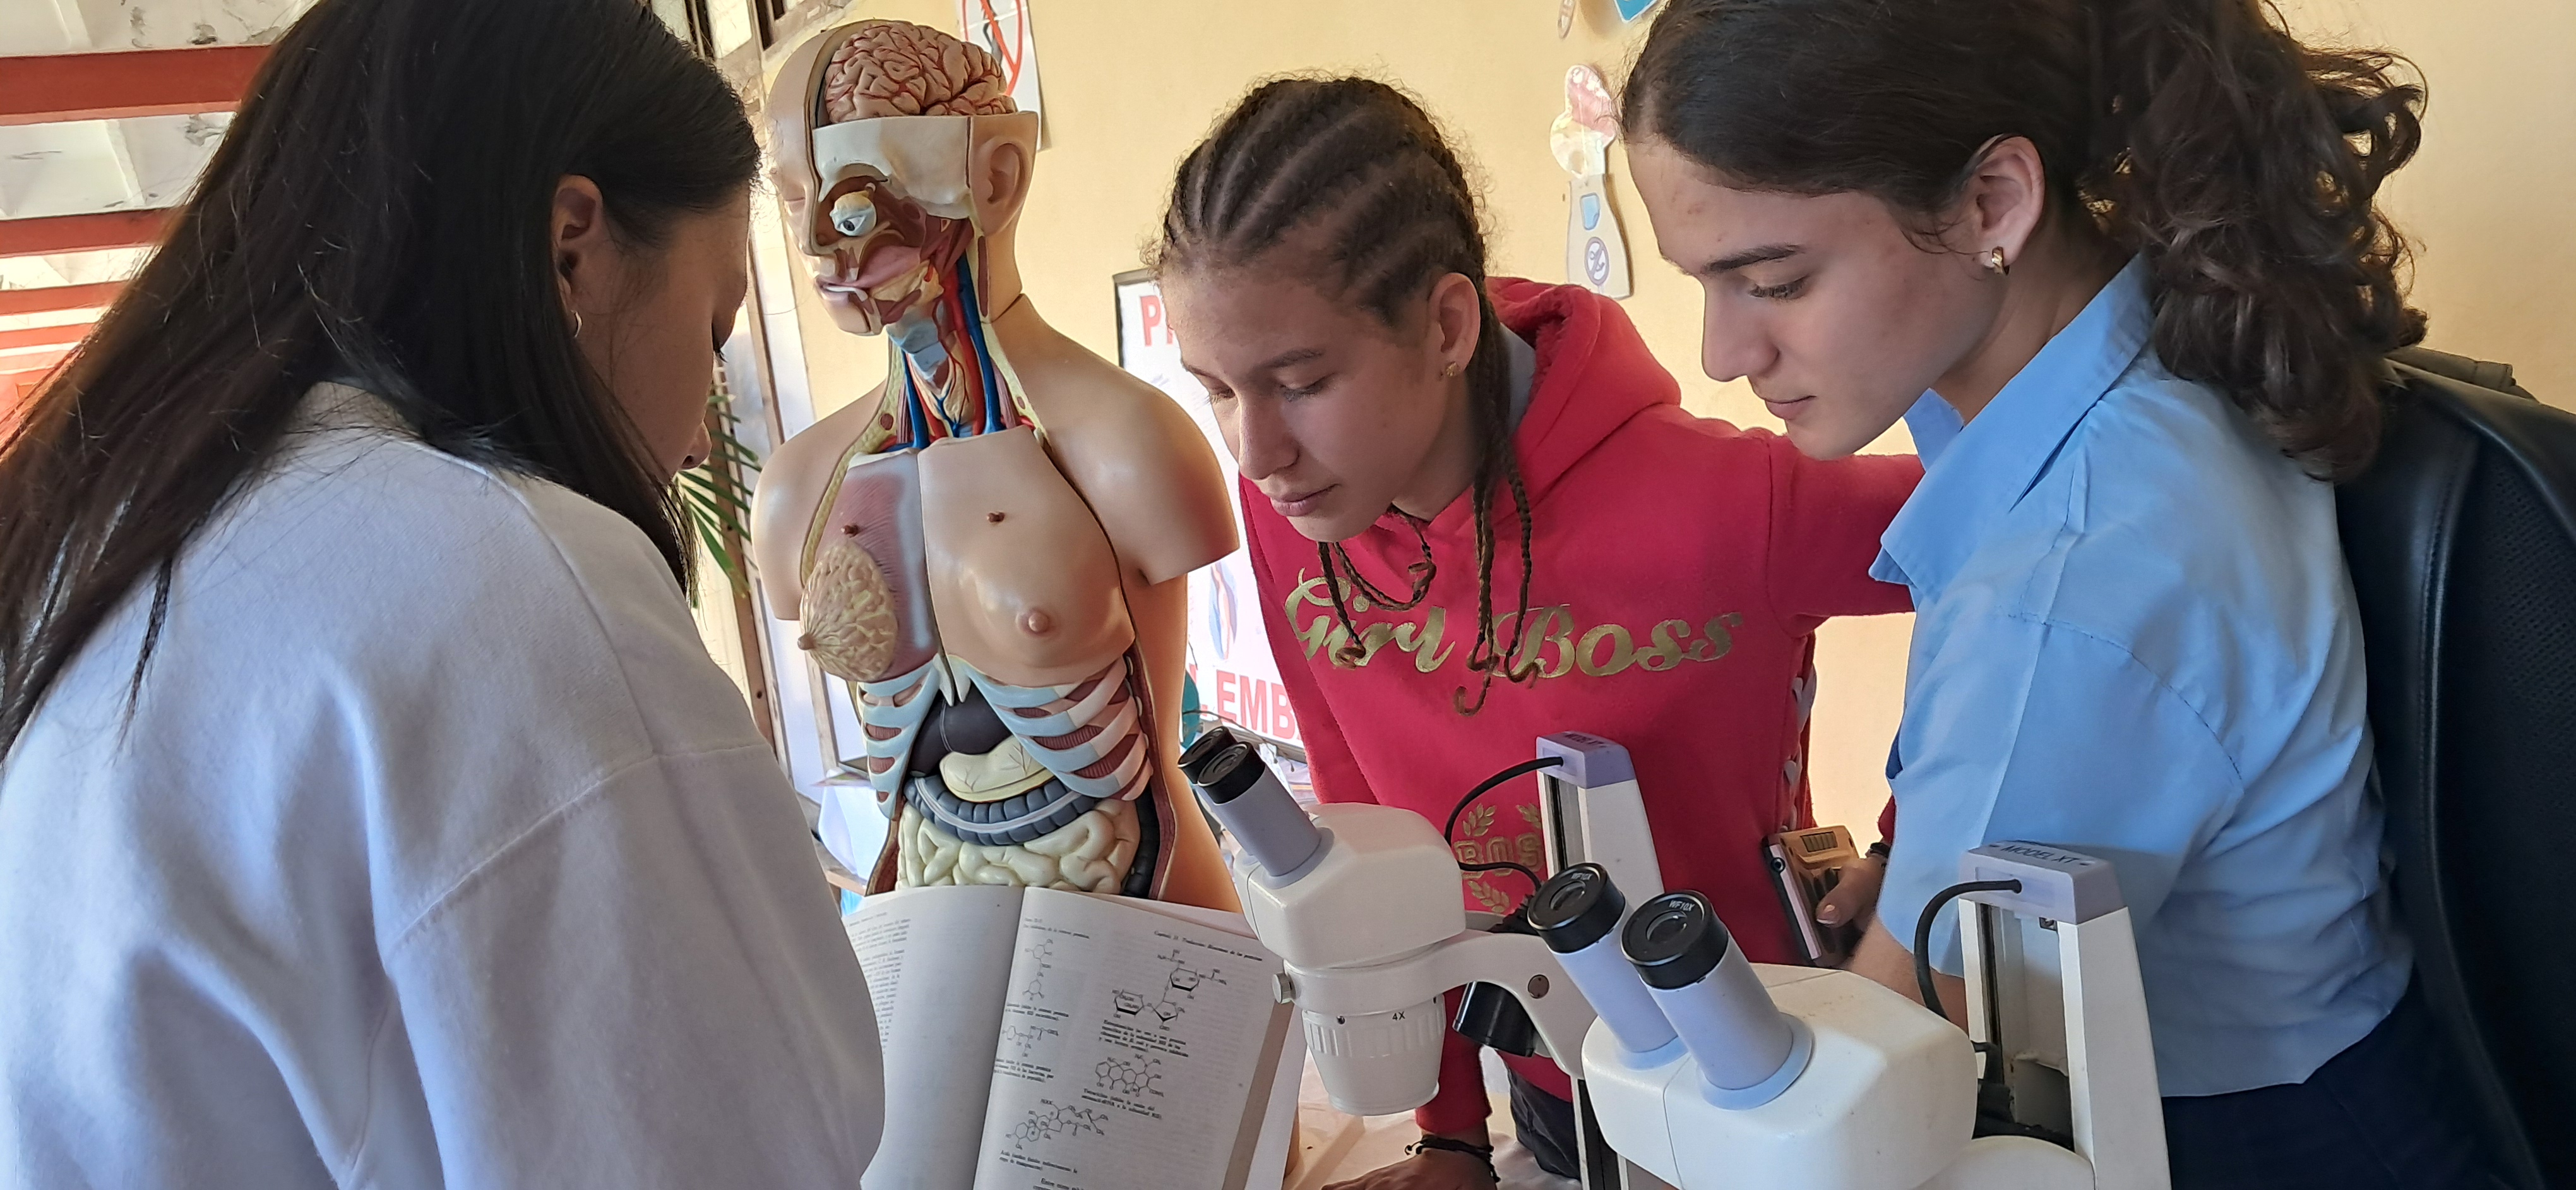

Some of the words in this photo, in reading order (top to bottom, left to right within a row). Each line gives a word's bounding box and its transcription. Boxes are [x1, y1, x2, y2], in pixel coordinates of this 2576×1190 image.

[1140, 295, 1174, 347] P
[1284, 567, 1455, 673] Girl
[1217, 670, 1302, 740] EMB
[2000, 845, 2053, 861] MODEL
[2052, 855, 2080, 863] XT
[1571, 872, 1593, 881] WF10X
[1669, 900, 1695, 912] WF10X
[1392, 1011, 1405, 1021] 4X
